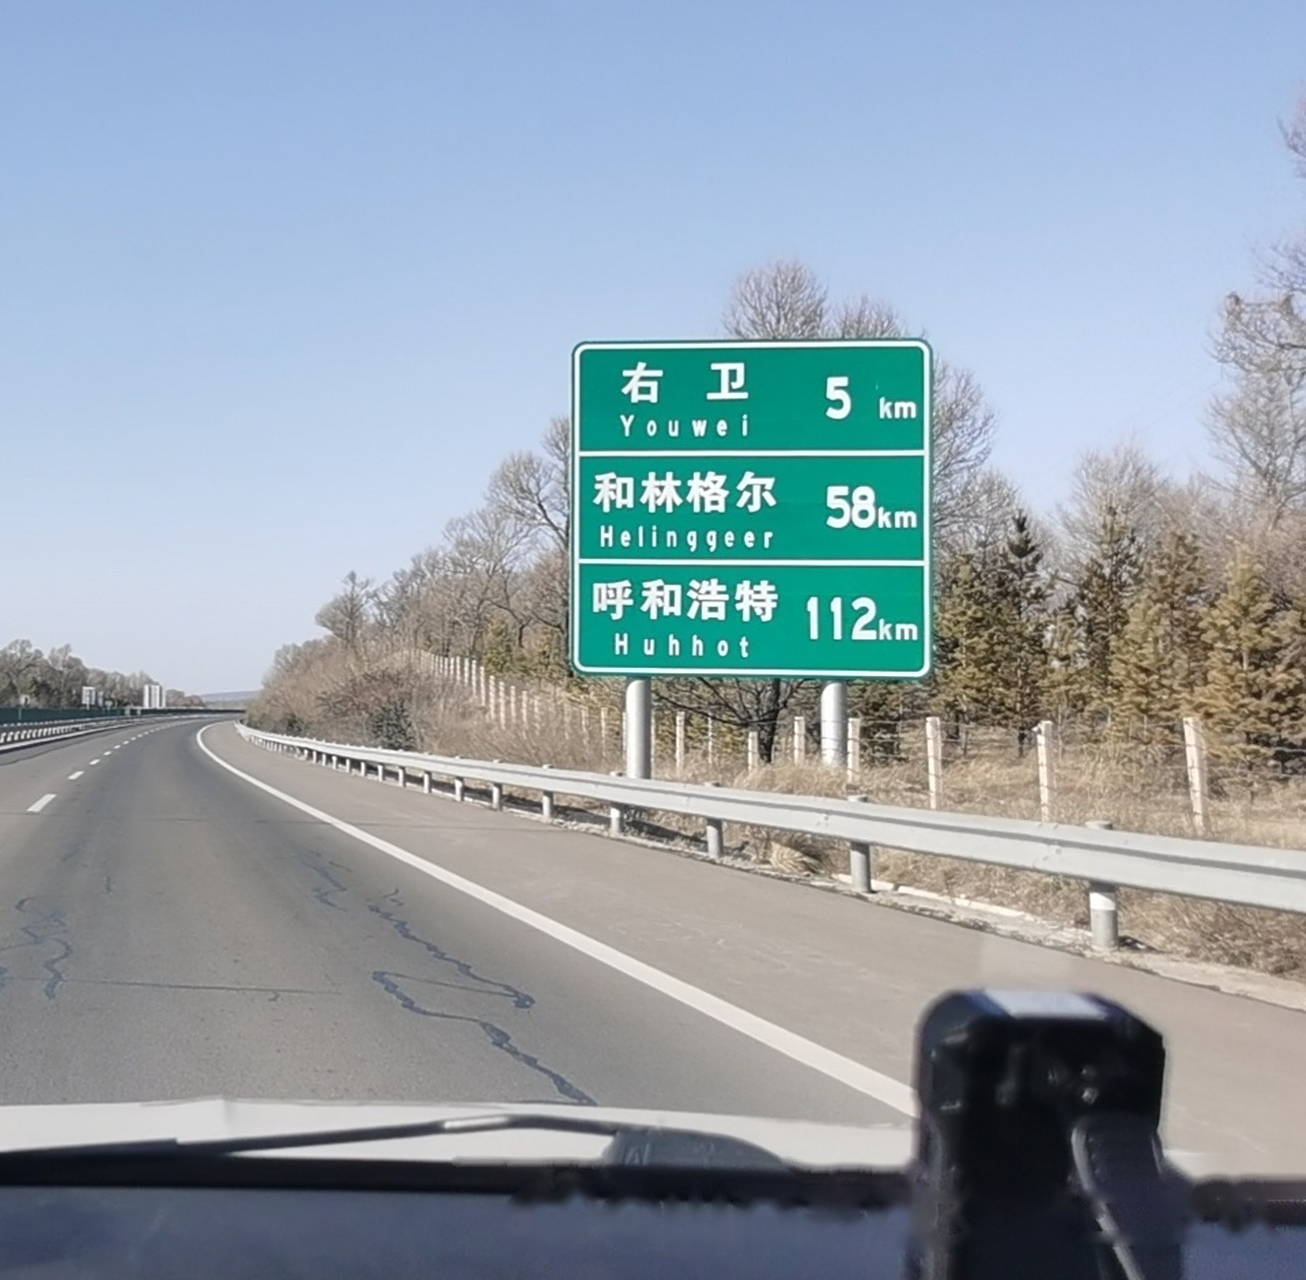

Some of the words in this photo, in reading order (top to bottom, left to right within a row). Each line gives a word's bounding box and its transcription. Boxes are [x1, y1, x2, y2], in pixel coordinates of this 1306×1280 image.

[622, 362, 748, 403] 右卫
[827, 377, 851, 419] 5
[880, 398, 916, 418] km
[621, 415, 747, 436] Youwei
[594, 472, 776, 513] 和林格尔
[601, 526, 772, 552] Helinggeer
[593, 579, 778, 621] 呼和浩特
[615, 634, 748, 657] Huhhot
